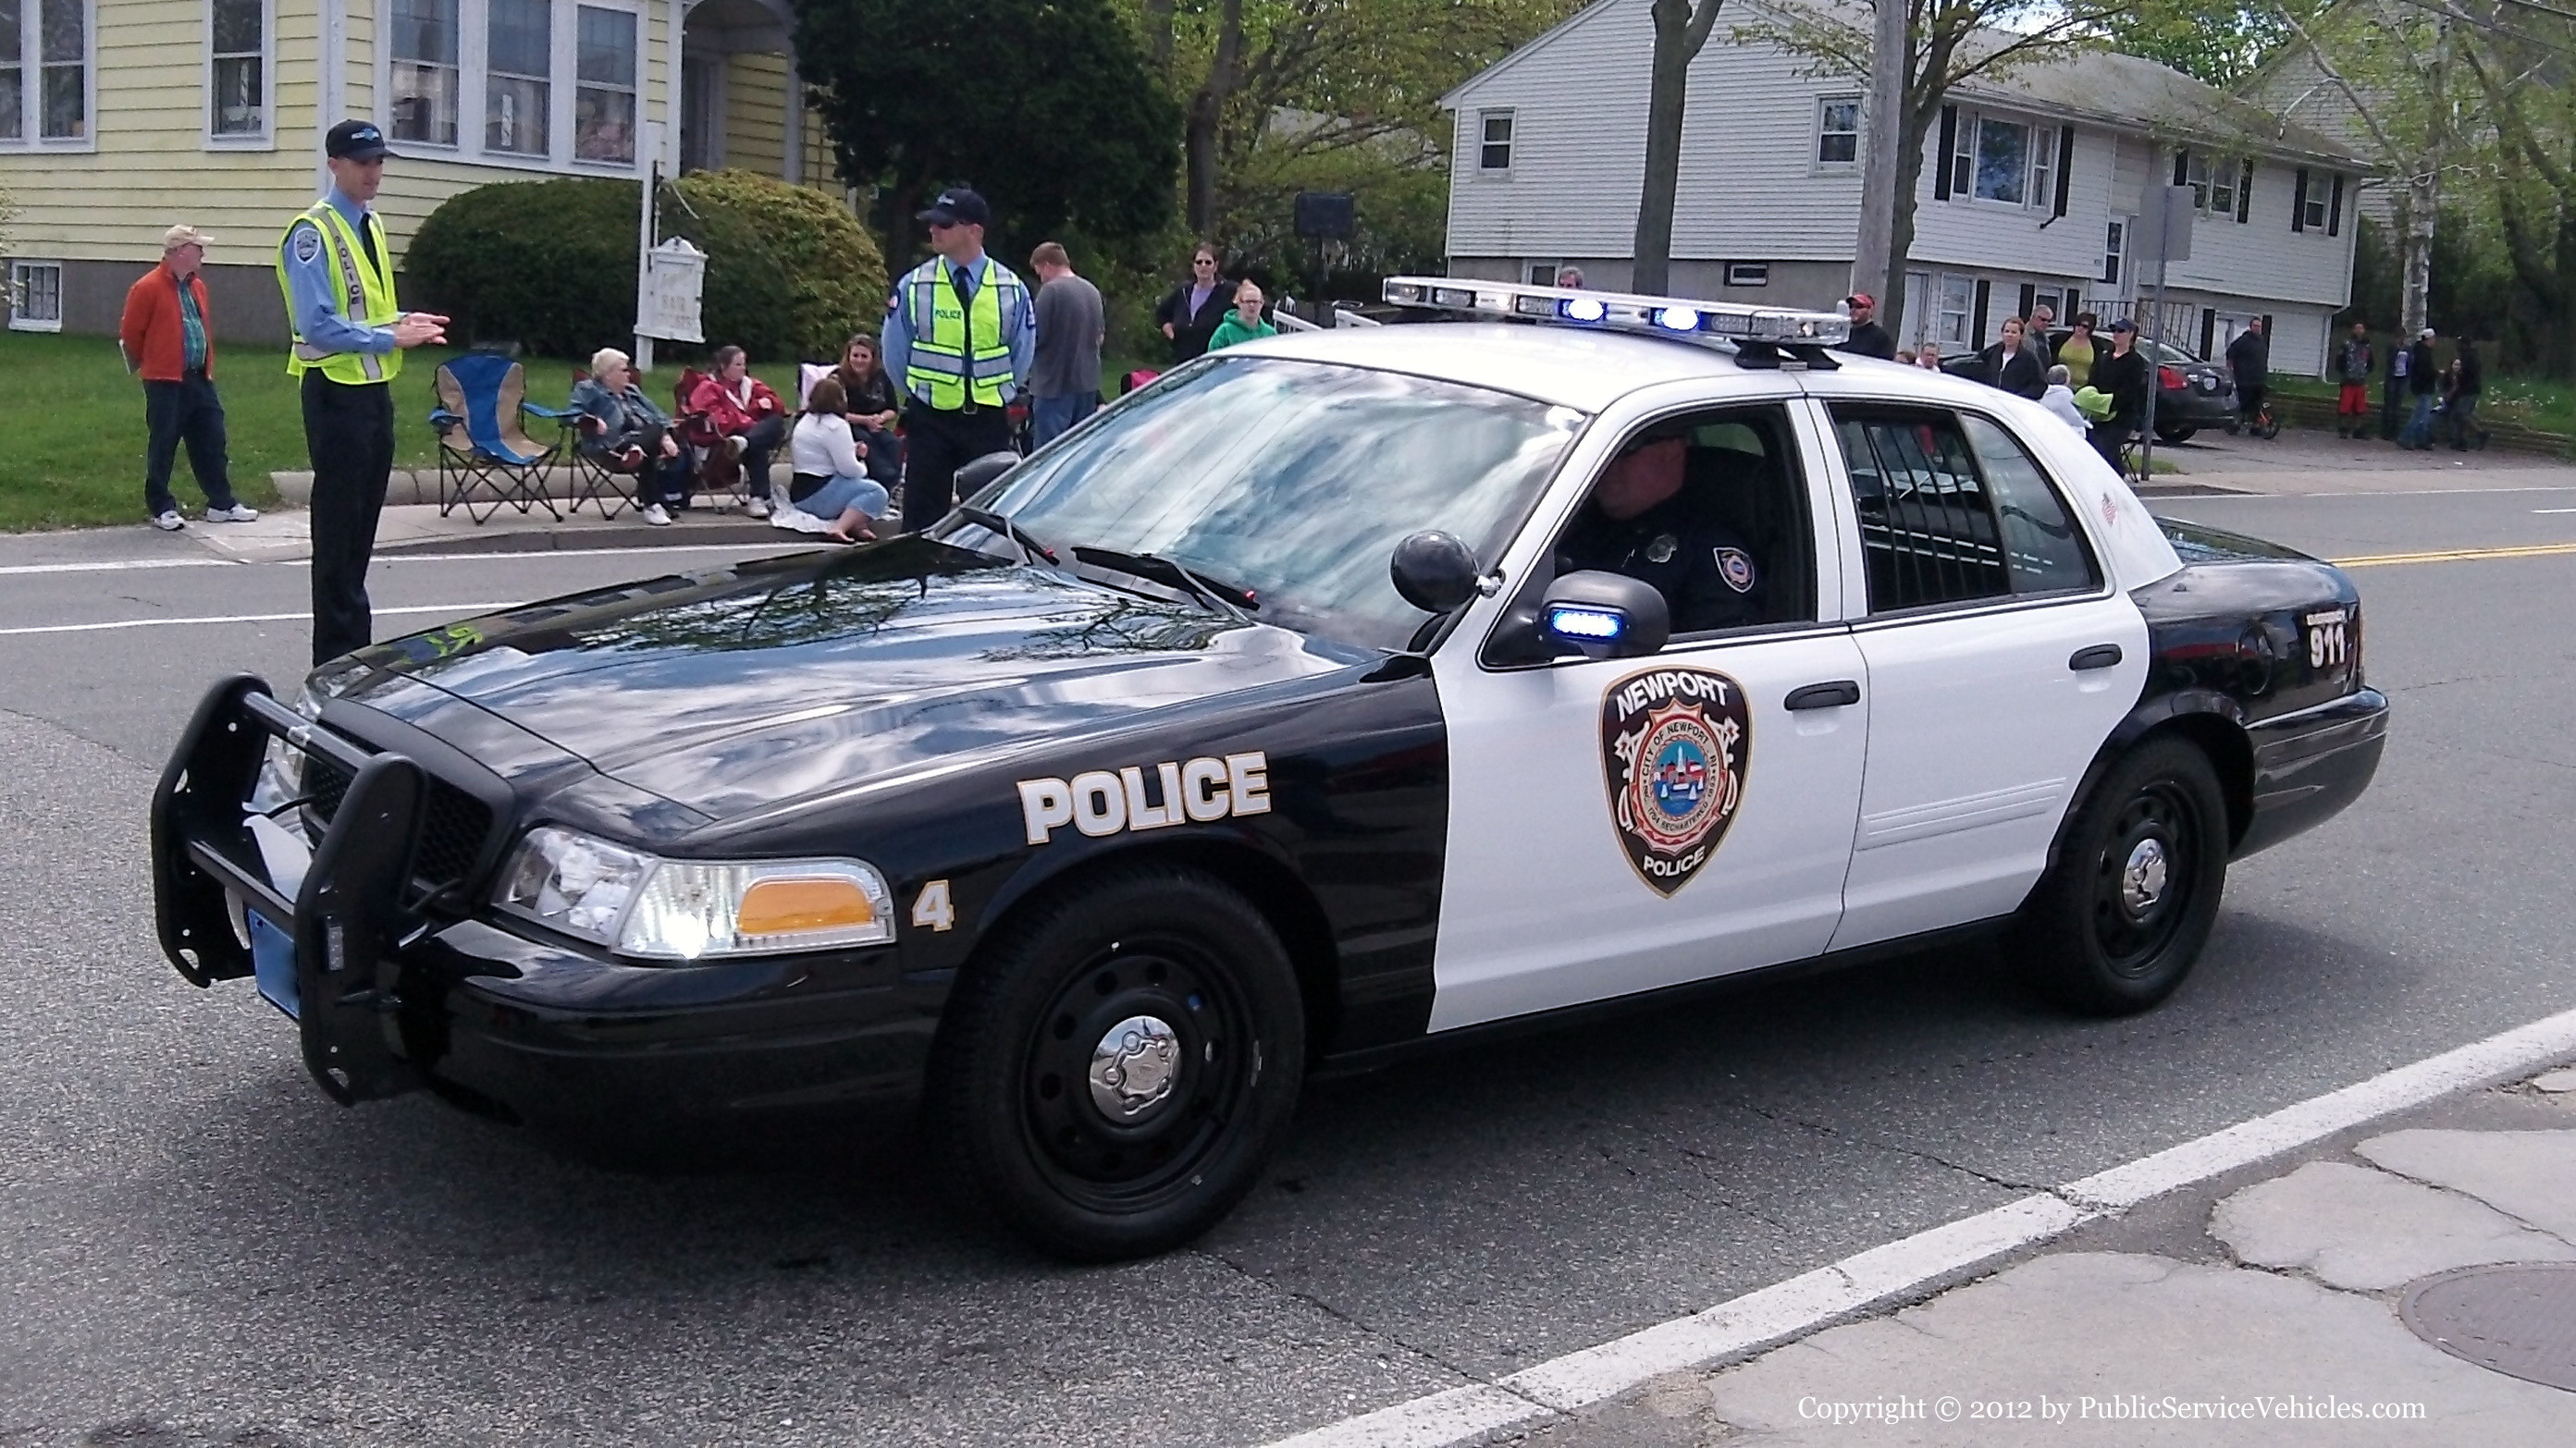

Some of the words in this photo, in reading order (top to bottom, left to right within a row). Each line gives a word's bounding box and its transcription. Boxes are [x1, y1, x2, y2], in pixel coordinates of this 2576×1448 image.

[334, 235, 361, 305] POLICE
[935, 309, 961, 320] POLICE
[2310, 623, 2346, 669] 911
[1616, 671, 1728, 722] NEWPORT
[1642, 749, 1654, 777] CITY
[1653, 730, 1665, 745] OF
[1017, 751, 1271, 845] POLICE
[1643, 845, 1706, 877] POLICE
[912, 878, 955, 932] 4
